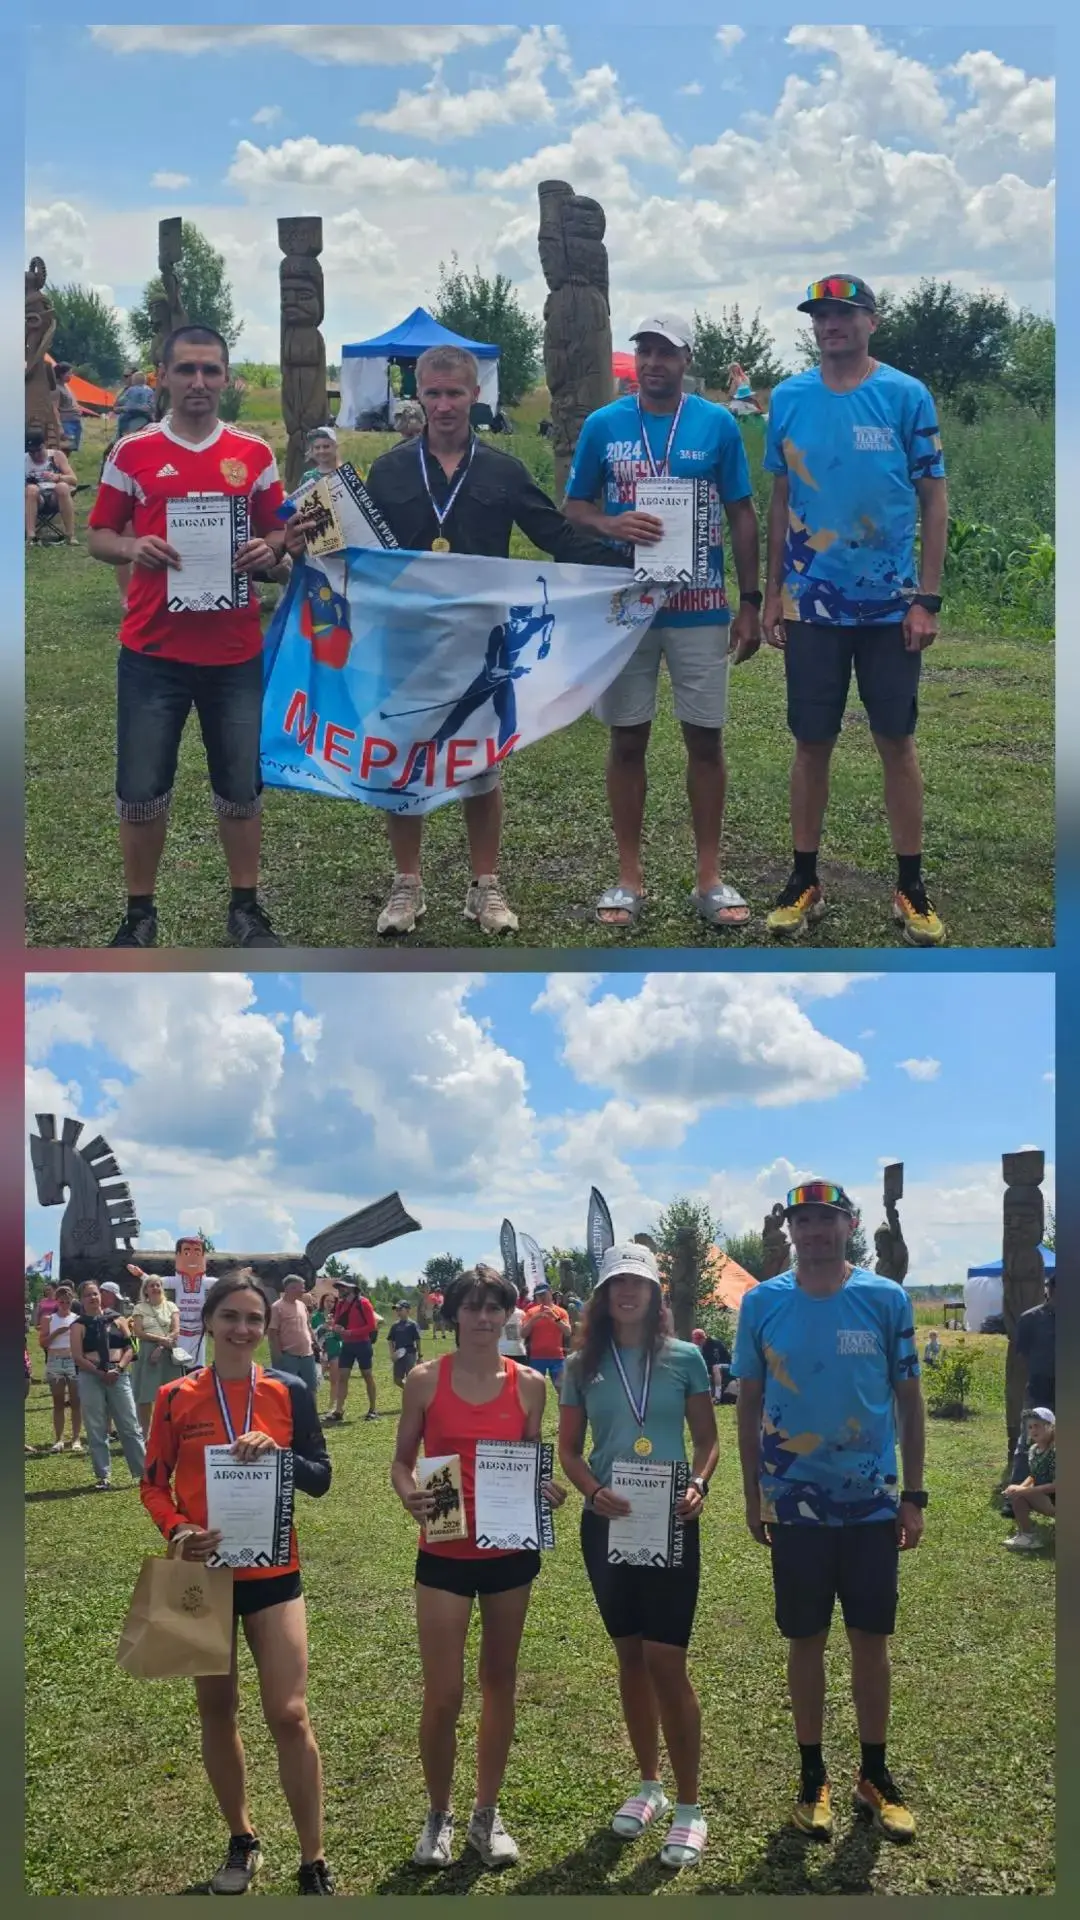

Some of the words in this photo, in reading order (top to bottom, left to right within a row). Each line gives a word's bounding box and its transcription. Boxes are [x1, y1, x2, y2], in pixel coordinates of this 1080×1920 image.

[605, 440, 642, 463] 2024
[343, 464, 360, 488] 2026
[639, 497, 689, 506] АБСОЛЮТ
[698, 480, 708, 505] 2026
[236, 495, 247, 522] 2026
[170, 517, 226, 528] АБСОЛЮТ
[378, 520, 399, 548] АВЛА
[698, 545, 708, 581] ТАВЛА
[283, 1451, 294, 1477] 2026
[478, 1461, 532, 1472] АБСОЛЮТ
[541, 1444, 552, 1469] 2026
[213, 1470, 272, 1480] АБСОЛЮТ
[614, 1476, 667, 1489] АБСОЛЮТ
[677, 1463, 688, 1487] 2026
[541, 1514, 554, 1549] ТАВЛА
[278, 1526, 291, 1566] ТАВЛА
[672, 1530, 684, 1568] ТАВЛА
